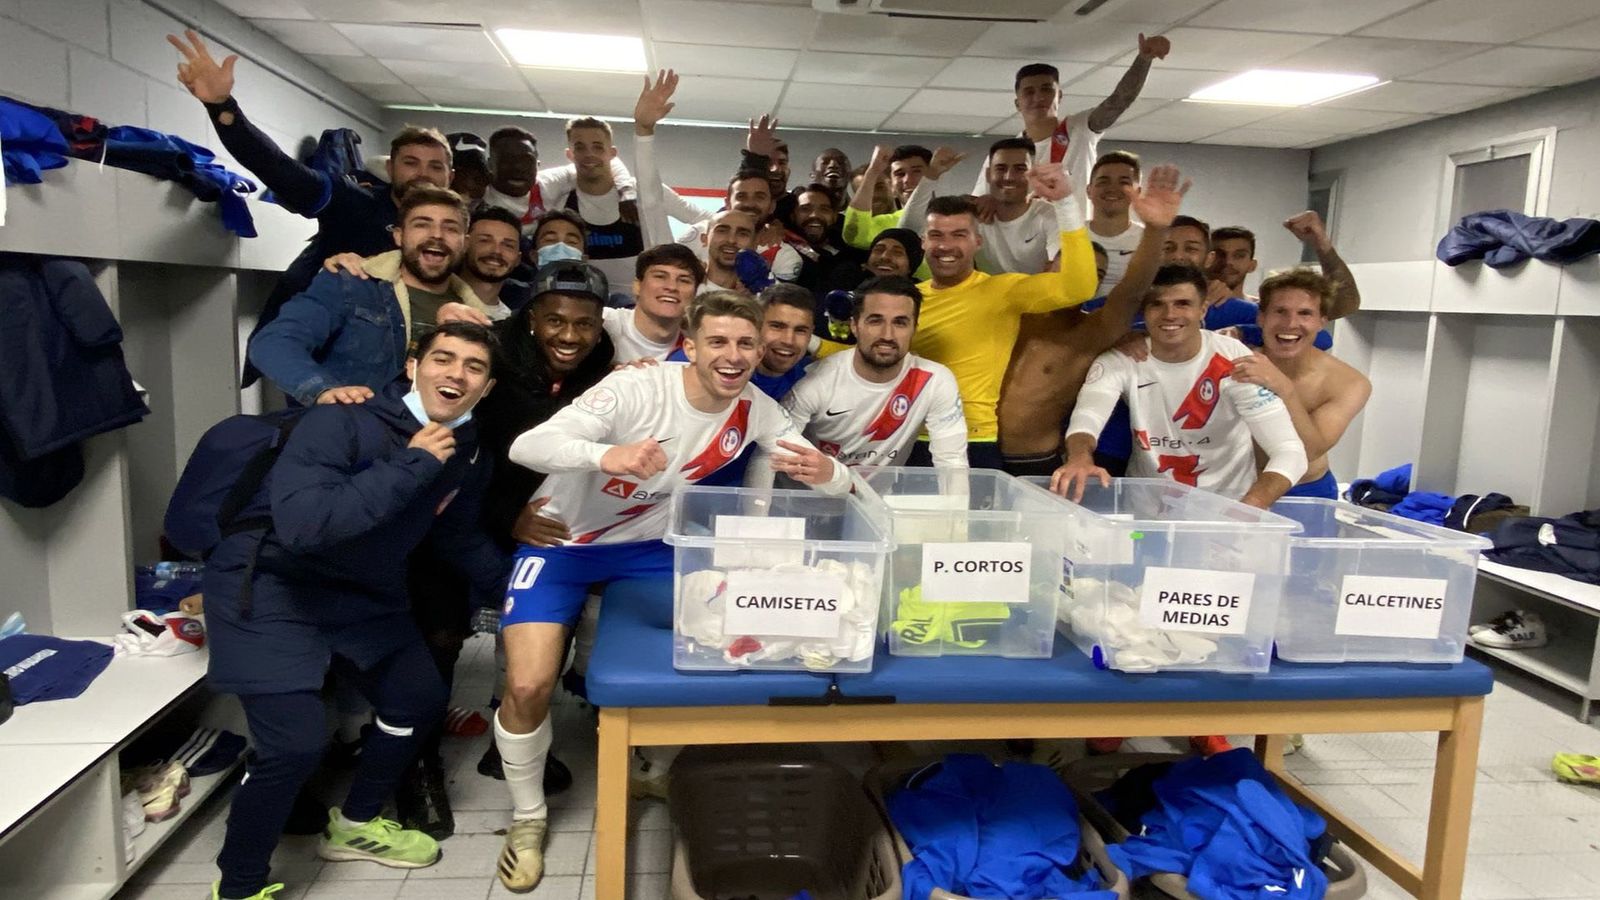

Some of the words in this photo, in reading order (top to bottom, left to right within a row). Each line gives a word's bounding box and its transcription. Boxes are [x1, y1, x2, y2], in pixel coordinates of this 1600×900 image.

[934, 560, 949, 573] P.
[953, 560, 1024, 573] CORTOS
[735, 595, 838, 611] CAMISETAS
[1158, 591, 1213, 607] PARES
[1217, 594, 1240, 608] DE
[1345, 593, 1443, 610] CALCETINES
[1162, 610, 1230, 627] MEDIAS
